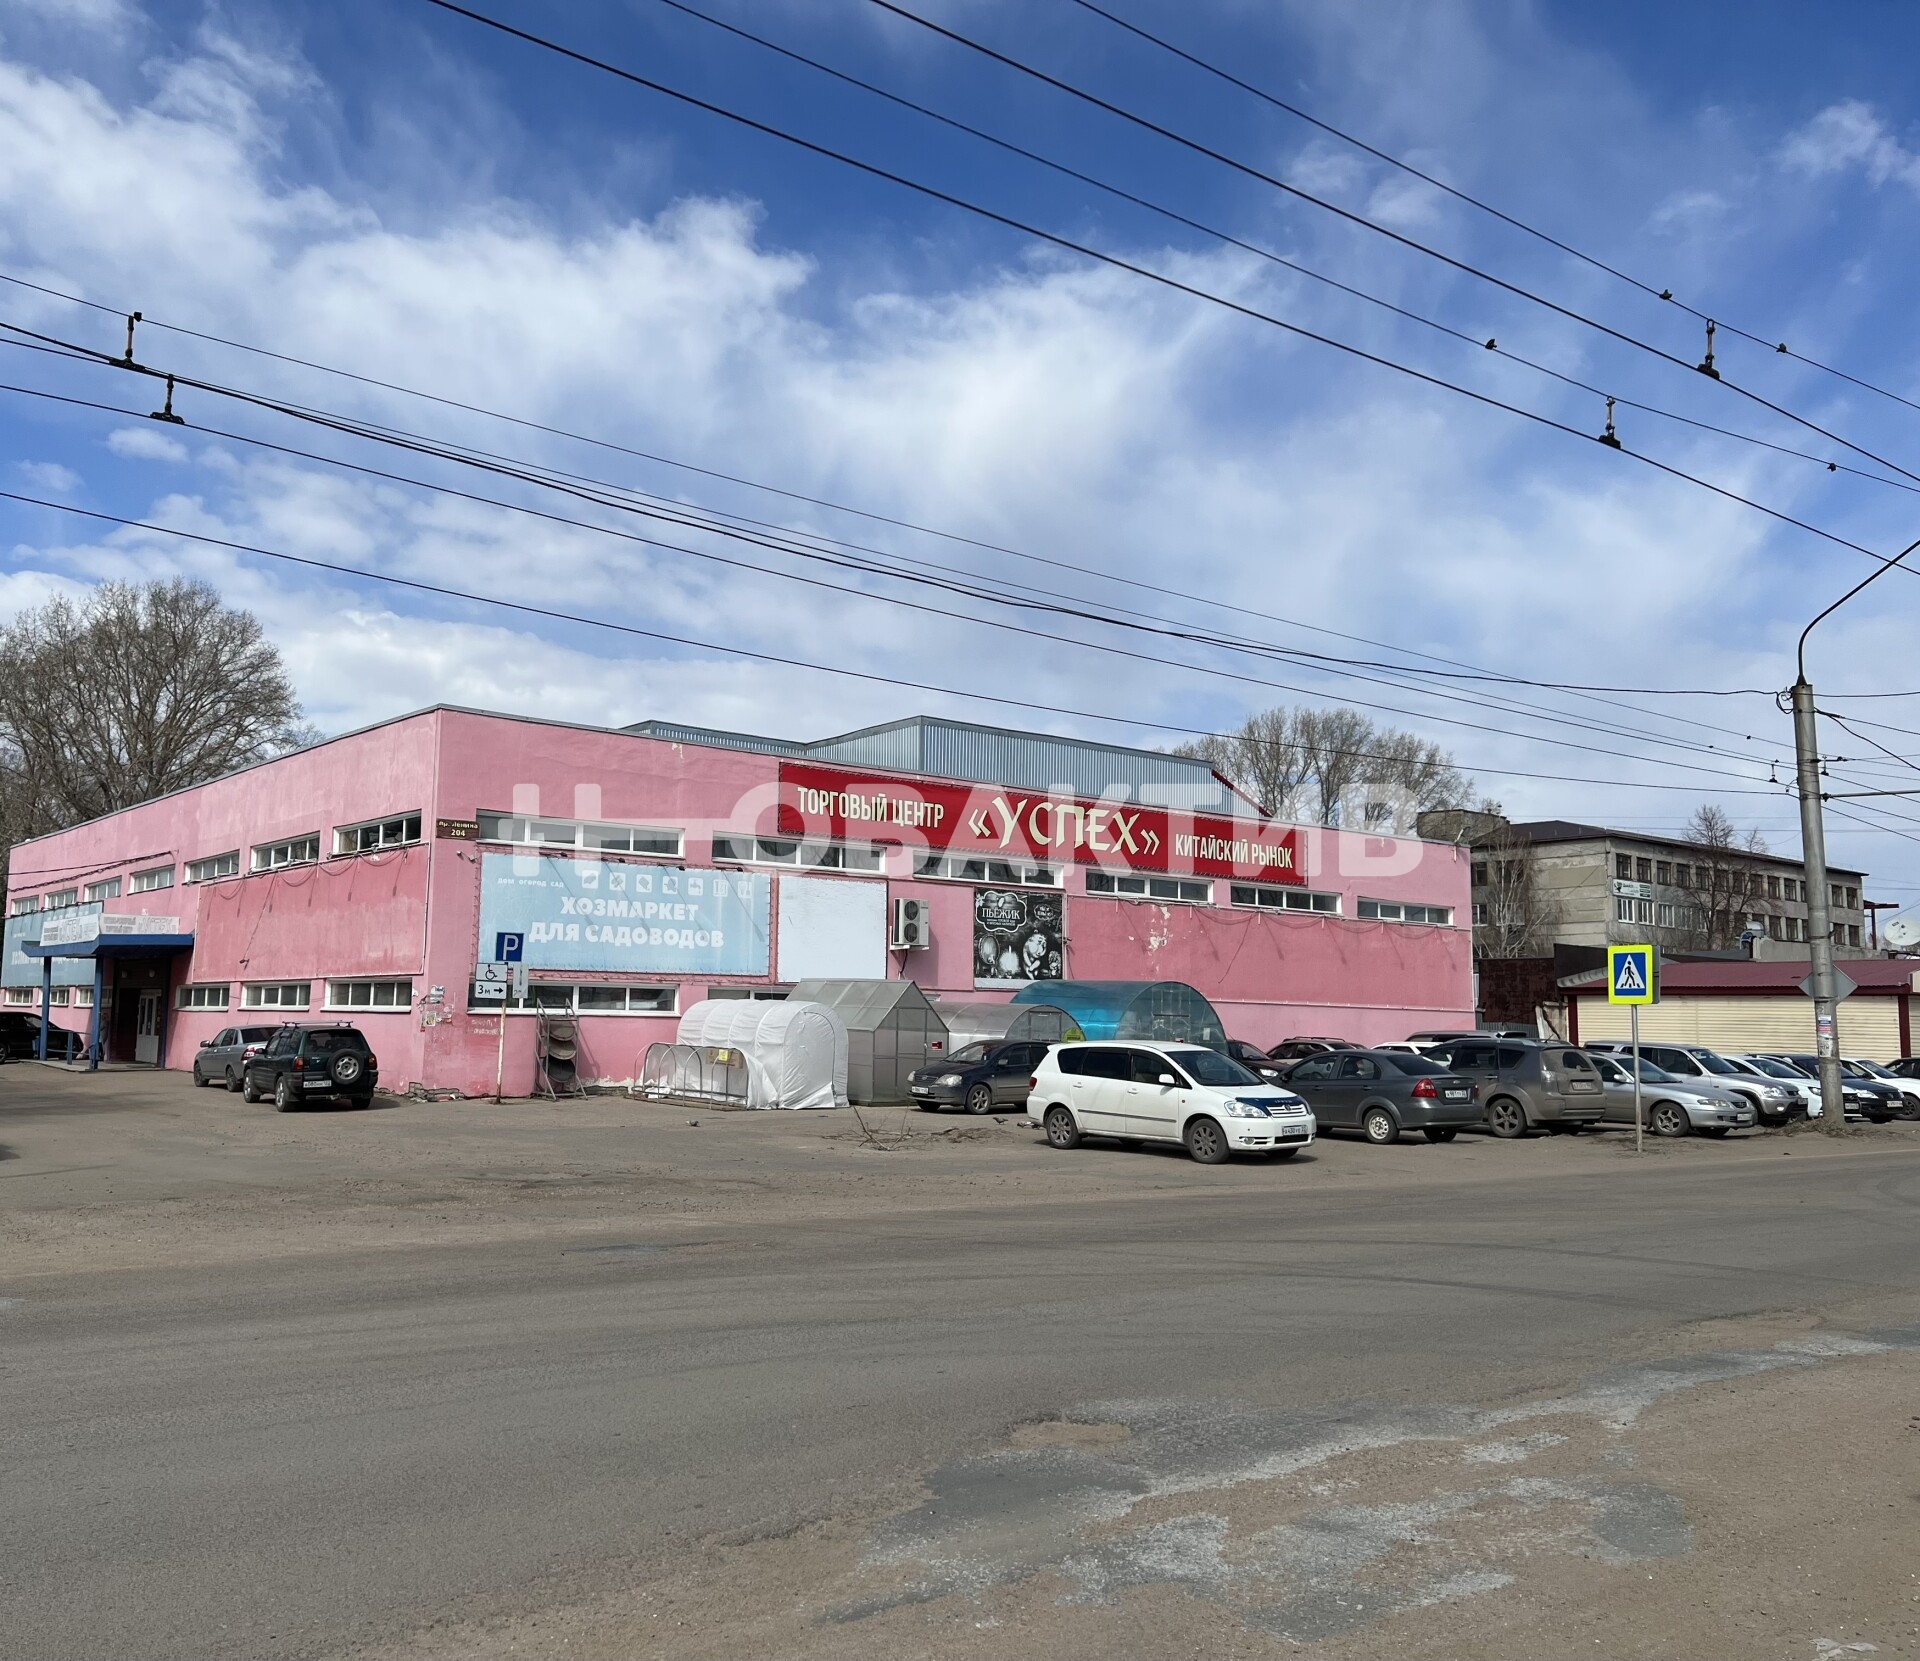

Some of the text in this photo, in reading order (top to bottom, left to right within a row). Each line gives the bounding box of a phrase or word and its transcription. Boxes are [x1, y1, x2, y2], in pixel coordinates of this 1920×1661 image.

[450, 829, 466, 837] 204
[797, 786, 1293, 869] ТОРГОВЫЙ ЦЕНТР «УСПЕХ» КИТАЙСКИЙ РЫНОК
[560, 896, 700, 921] ХОЗМАРКЕТ
[528, 922, 725, 949] ДЛЯ САДОВОДОВ
